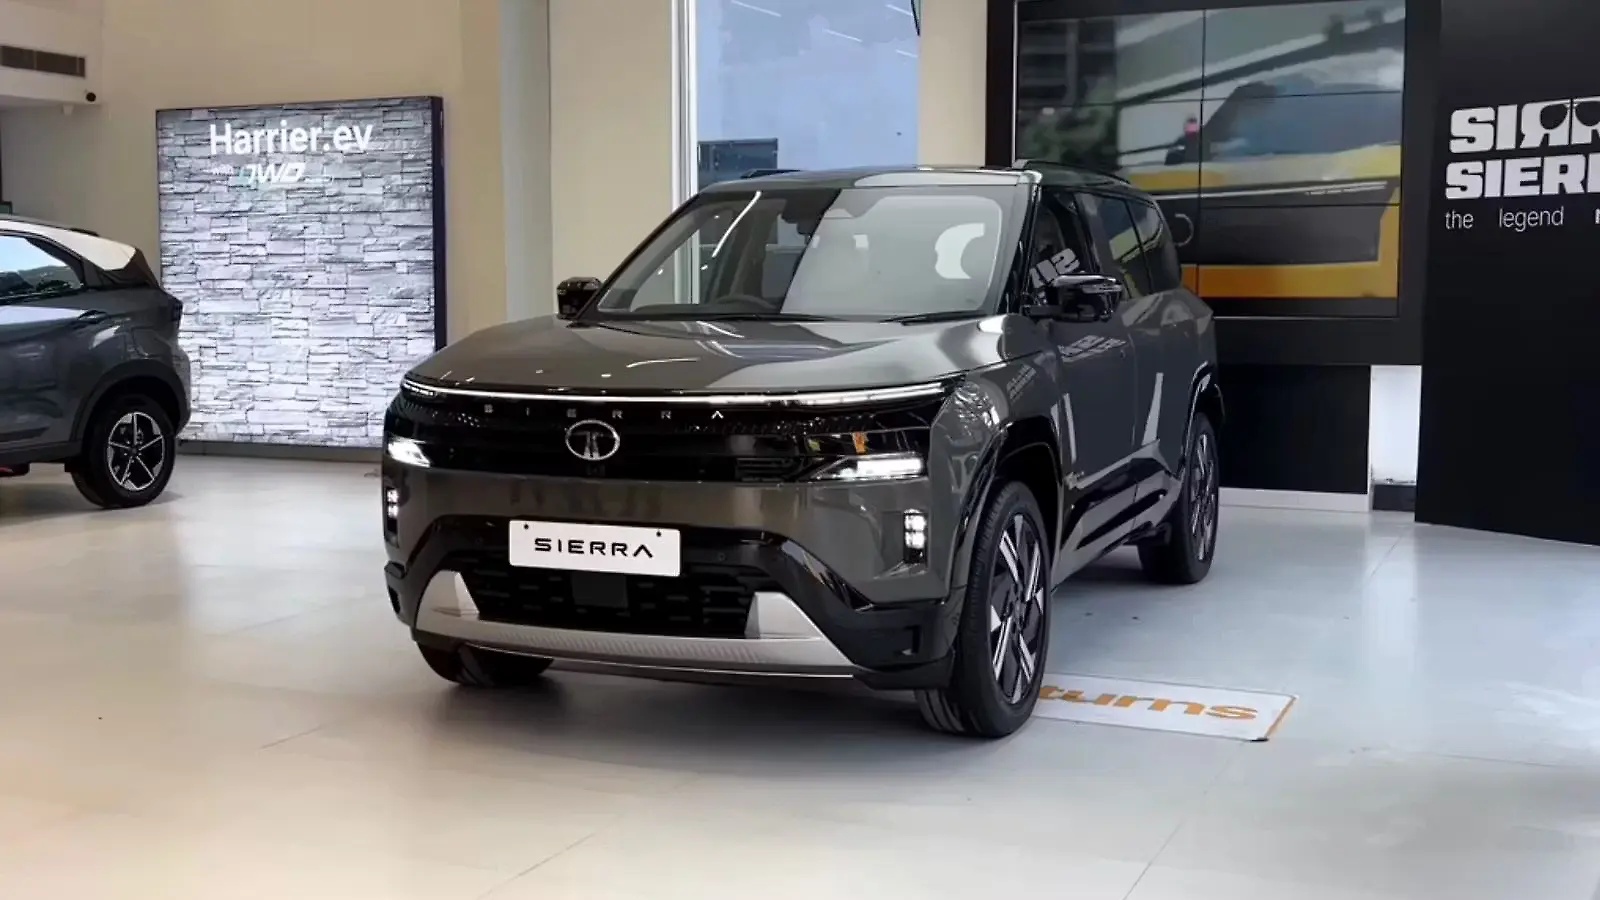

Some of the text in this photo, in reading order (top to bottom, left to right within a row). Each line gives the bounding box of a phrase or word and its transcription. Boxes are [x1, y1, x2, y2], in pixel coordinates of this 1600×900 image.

[209, 119, 374, 155] Harrier.ev
[1445, 206, 1564, 232] the legend
[484, 403, 724, 420] SIERRA
[534, 537, 653, 559] SIERRA
